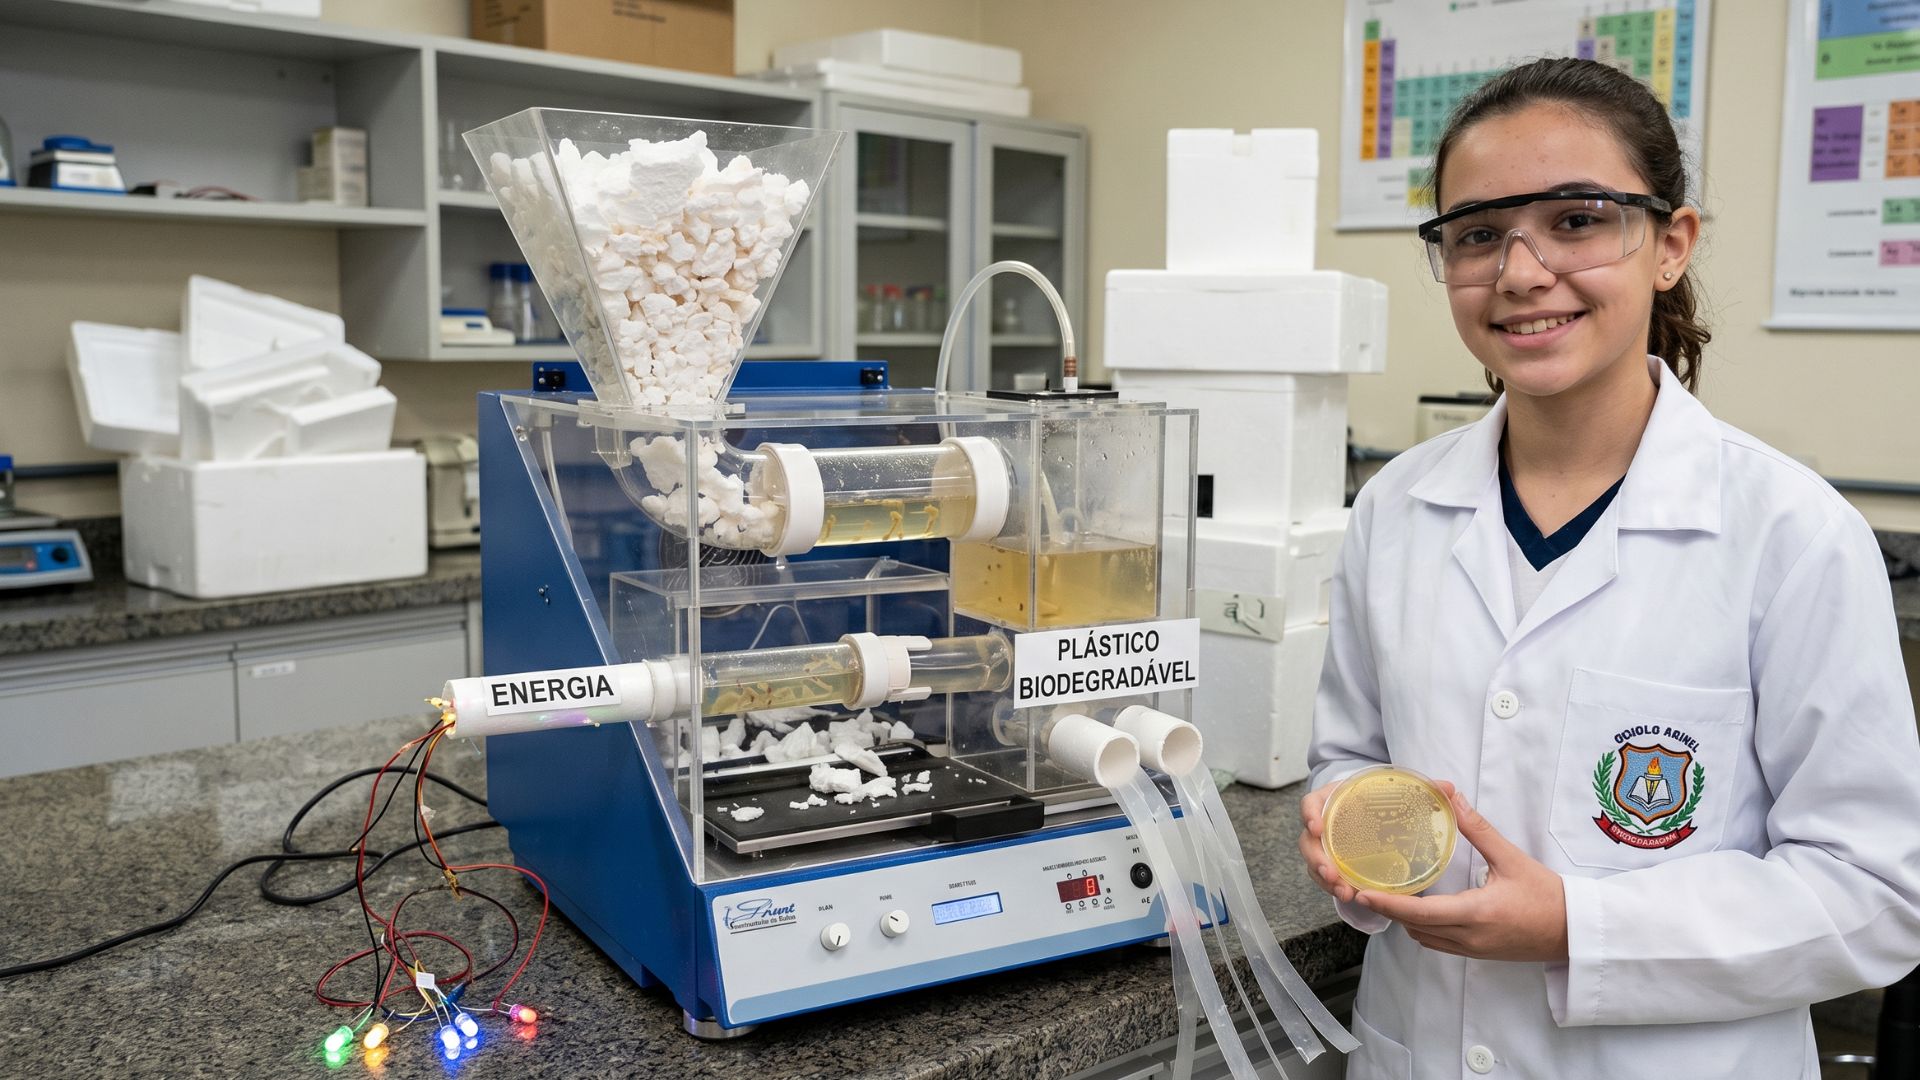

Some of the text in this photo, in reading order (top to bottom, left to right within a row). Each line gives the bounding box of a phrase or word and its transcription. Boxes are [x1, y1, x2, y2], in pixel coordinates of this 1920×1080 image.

[1058, 630, 1160, 661] PLÁSTICO
[491, 674, 615, 707] ENERGIA
[1019, 658, 1196, 700] BIODEGRADÁVEL
[1086, 877, 1096, 896] 8
